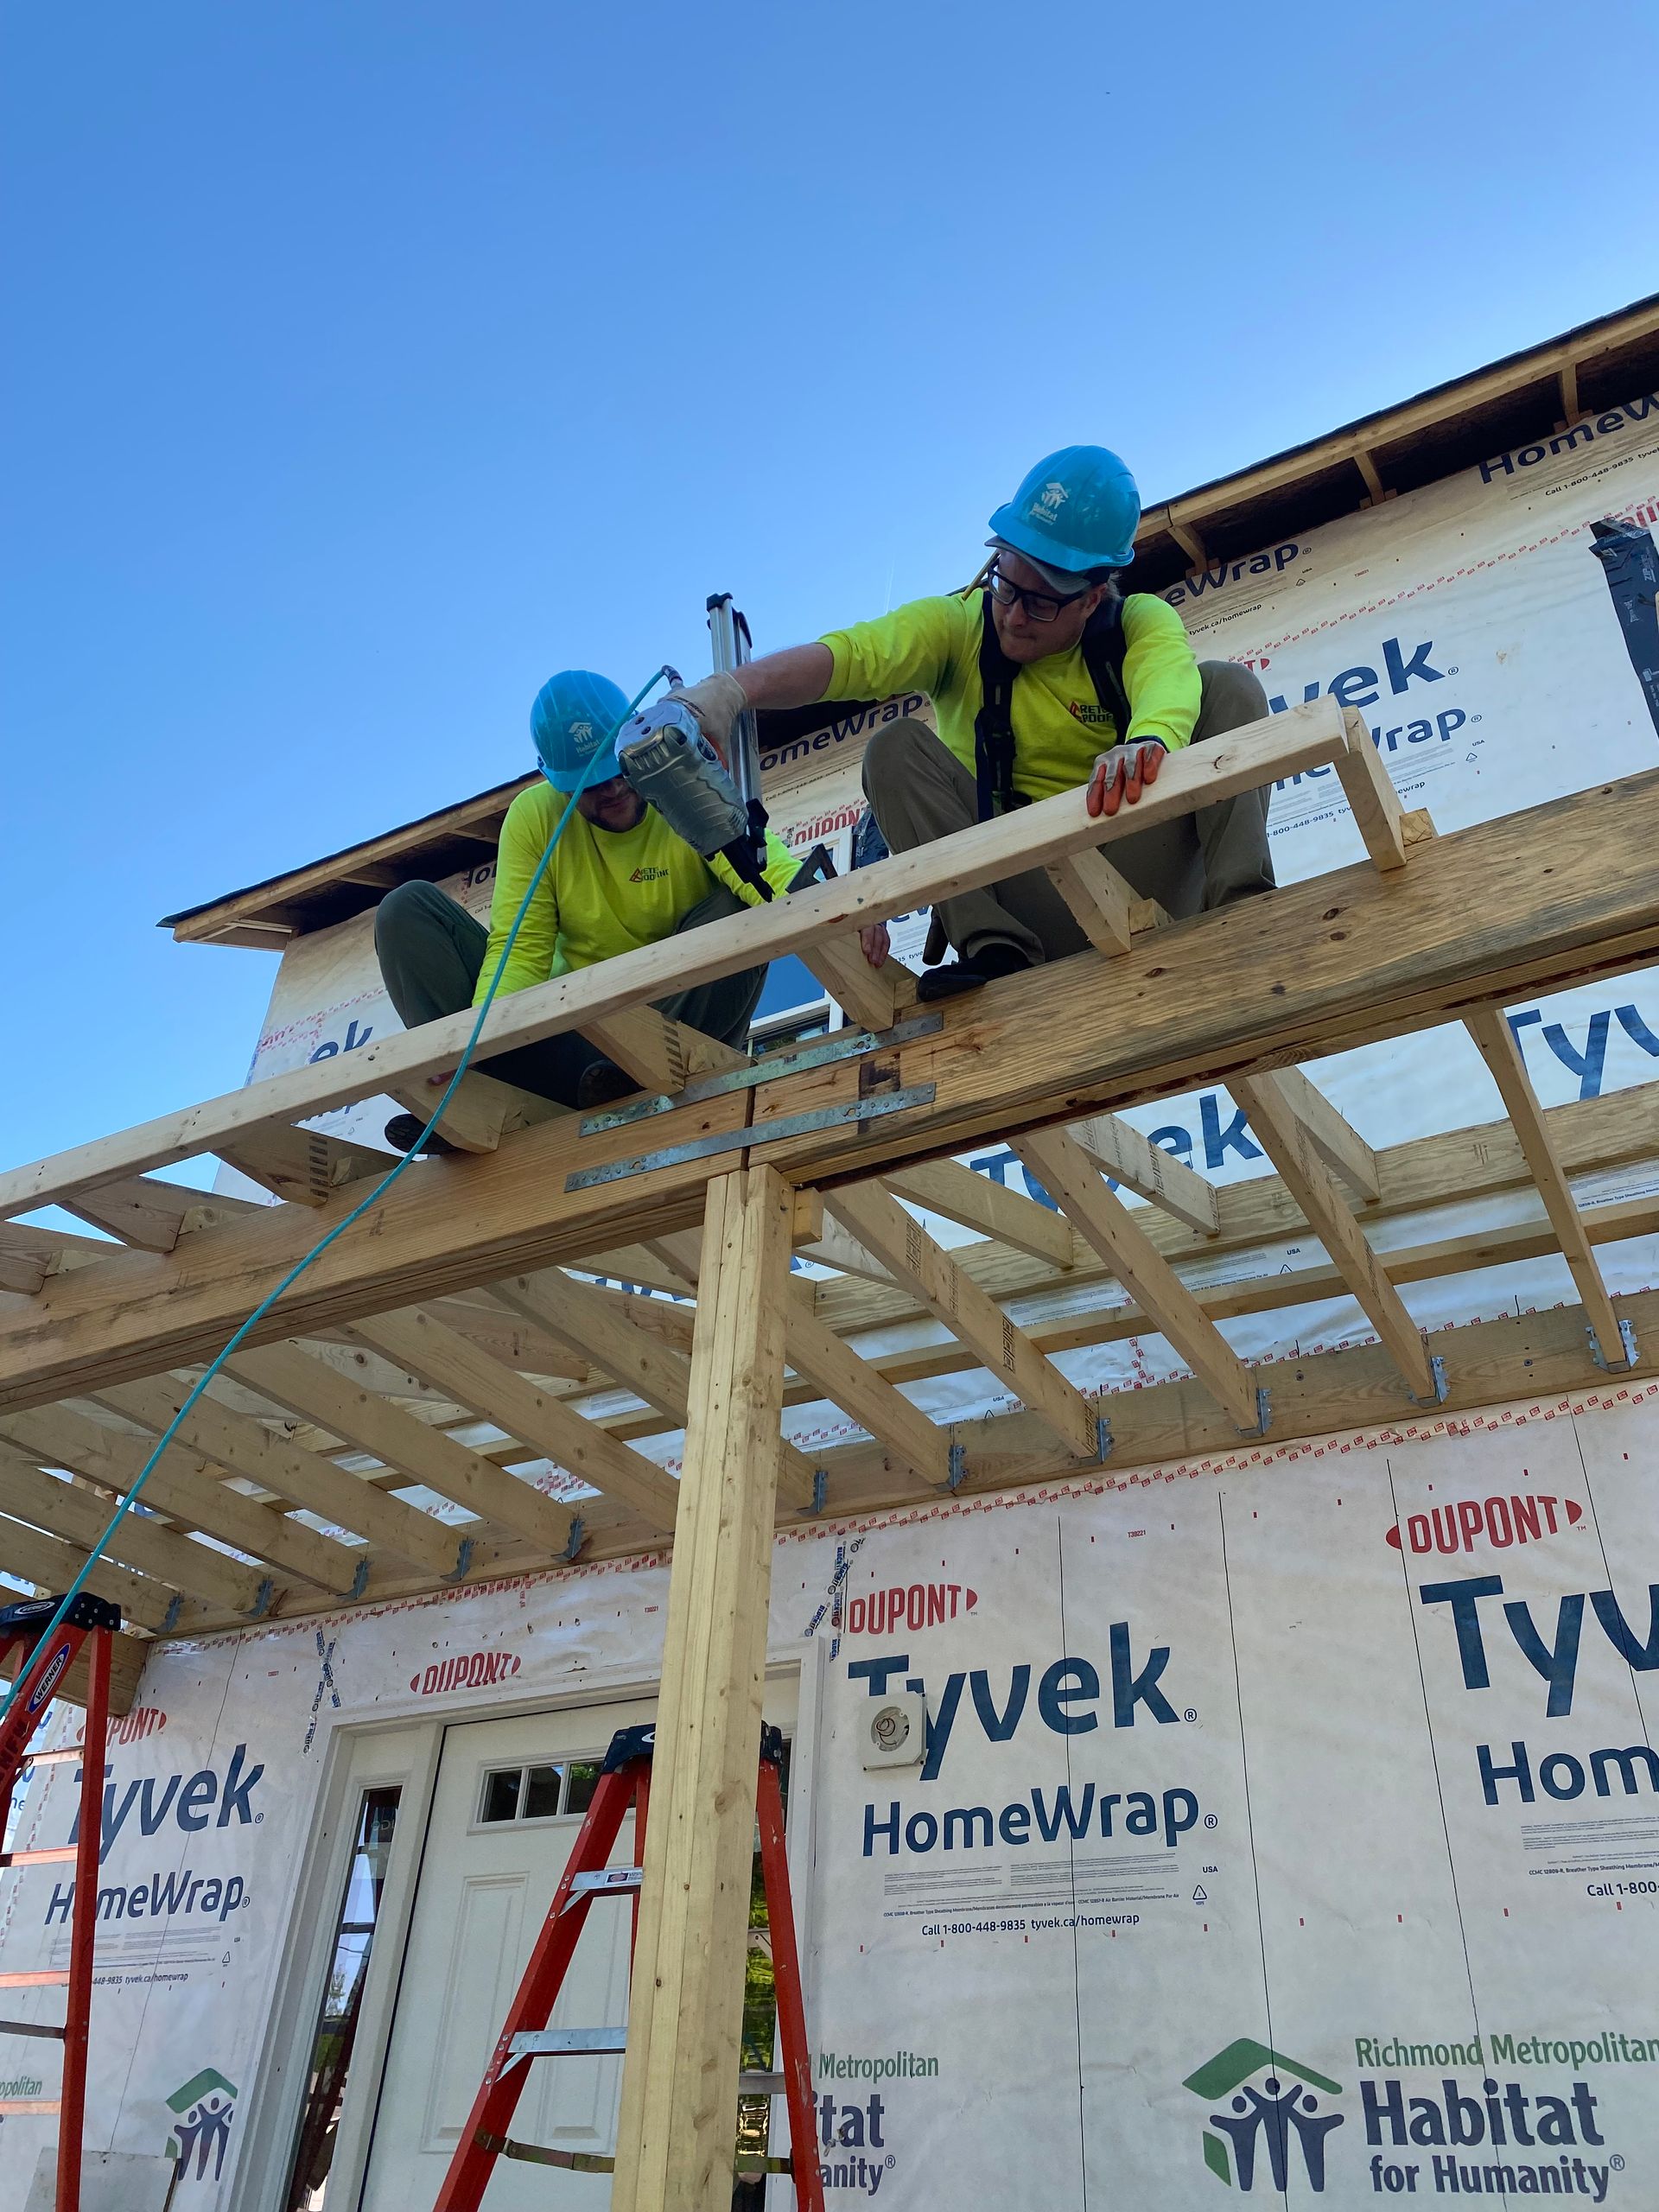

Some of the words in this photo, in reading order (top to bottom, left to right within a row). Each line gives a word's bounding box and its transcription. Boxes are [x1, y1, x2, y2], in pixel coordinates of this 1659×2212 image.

[1545, 486, 1562, 497] Call
[1287, 1247, 1300, 1255] USA
[1407, 1495, 1559, 1554] DUPONT
[849, 1583, 962, 1635] DUPONT
[35, 1656, 64, 1701] WERNER
[1587, 1884, 1614, 1897] Call
[922, 1923, 941, 1936] Call
[943, 1919, 1026, 1936] 1-800-448-9835
[1031, 1913, 1140, 1930] tyvek.ca/homewrap
[125, 1972, 188, 1985] tyvek.ca/homewrap
[818, 2050, 939, 2084] Metropolitan
[1355, 2034, 1484, 2068] Richmond
[1359, 2078, 1605, 2146] Habitat
[1370, 2155, 1420, 2193] for
